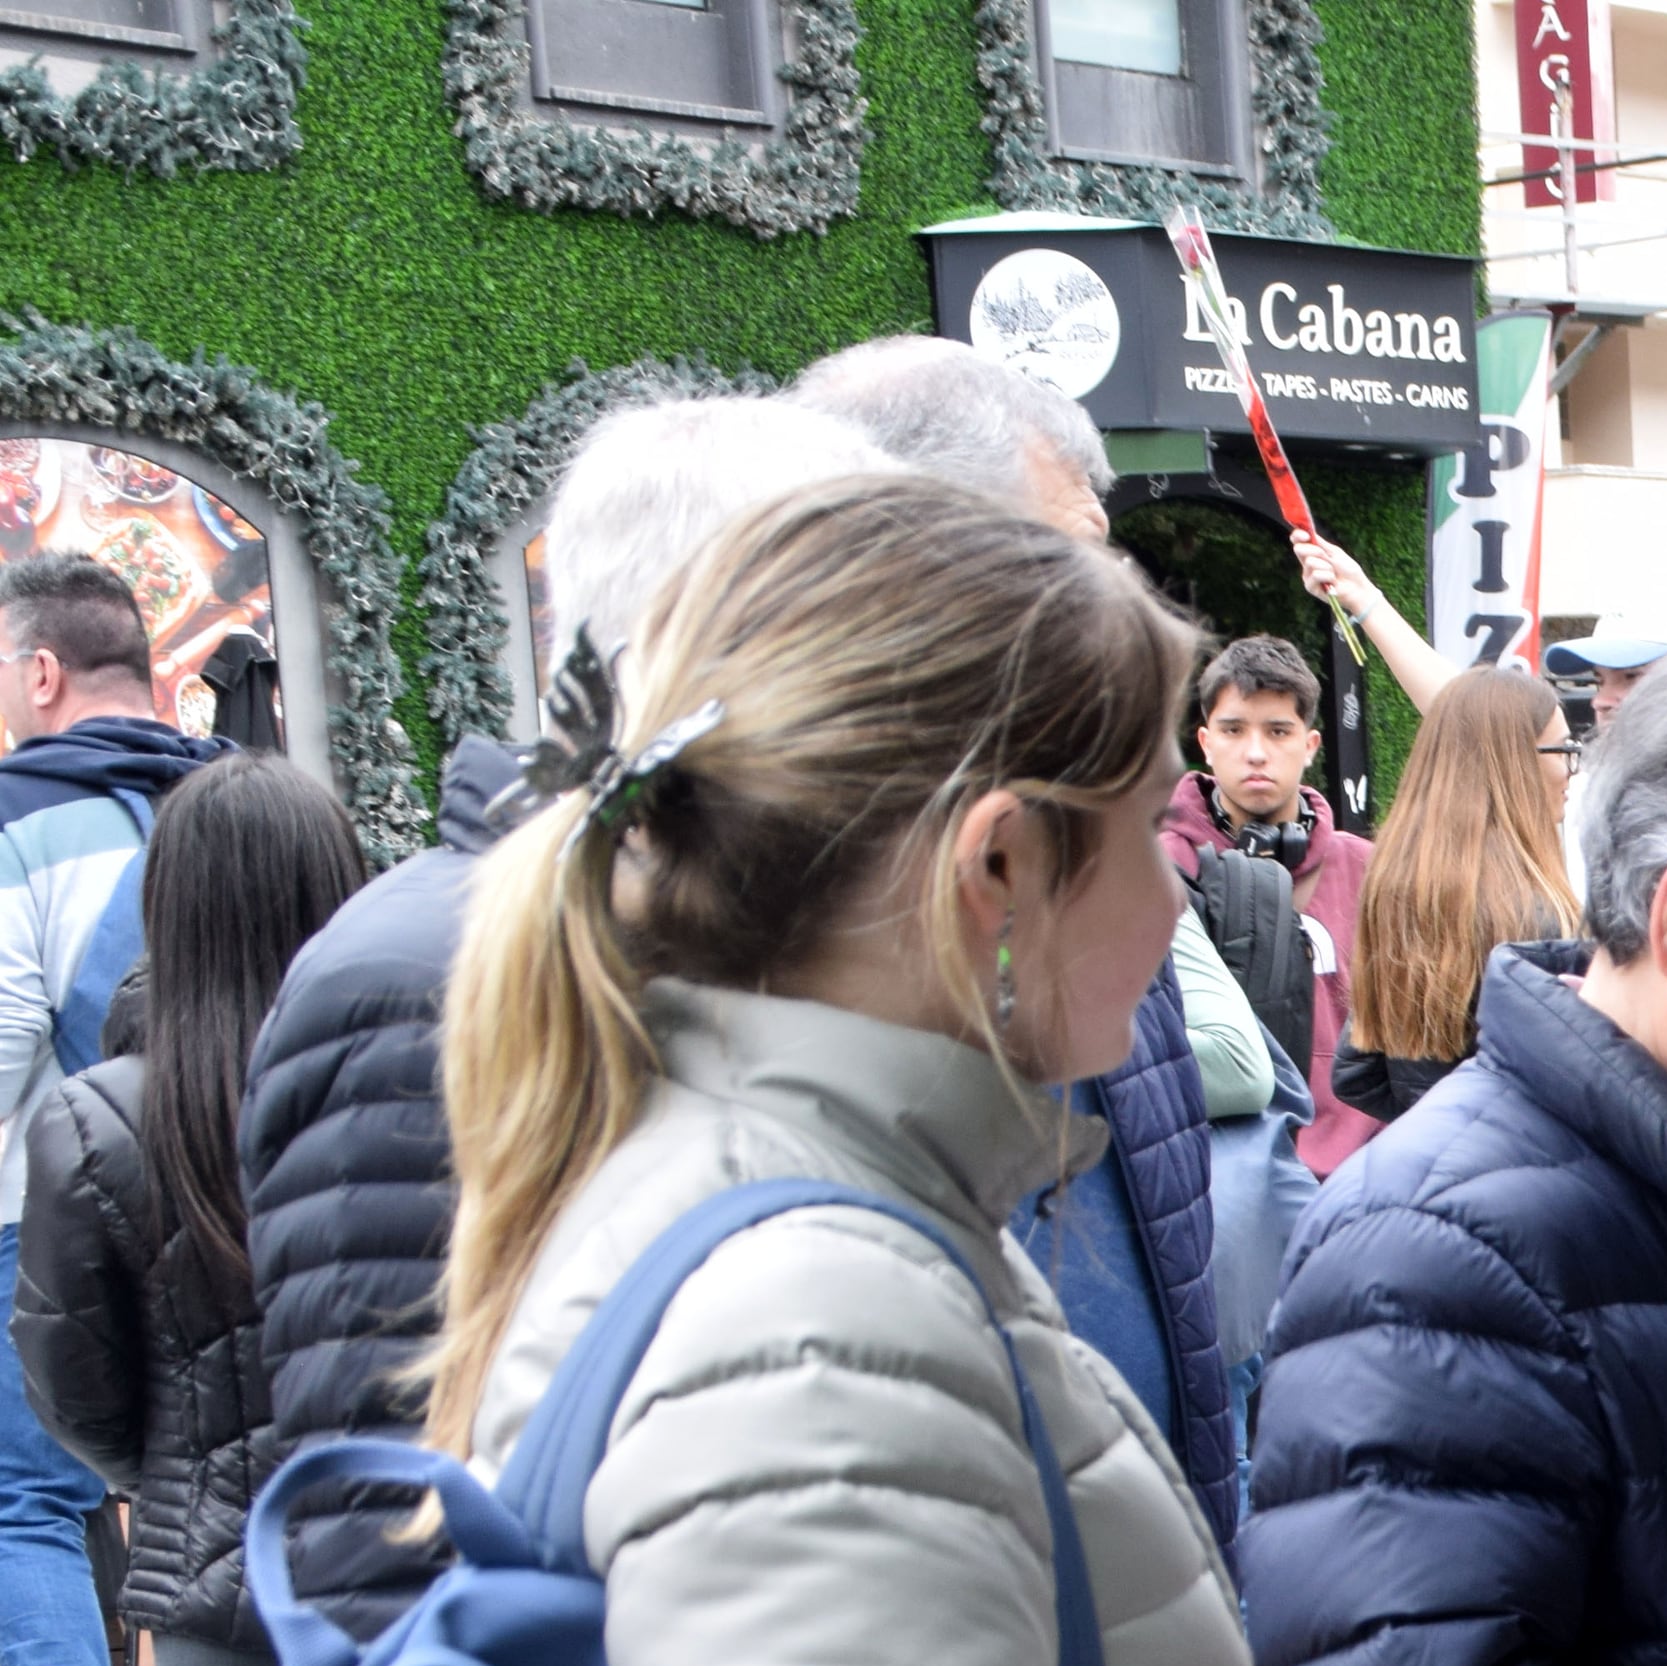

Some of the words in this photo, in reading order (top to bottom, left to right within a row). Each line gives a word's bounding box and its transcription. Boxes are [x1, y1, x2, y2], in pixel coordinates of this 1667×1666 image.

[1260, 281, 1467, 364] Cabana
[1263, 372, 1317, 400] TAPES
[1331, 378, 1393, 406] PASTES
[1406, 382, 1469, 410] CARNS
